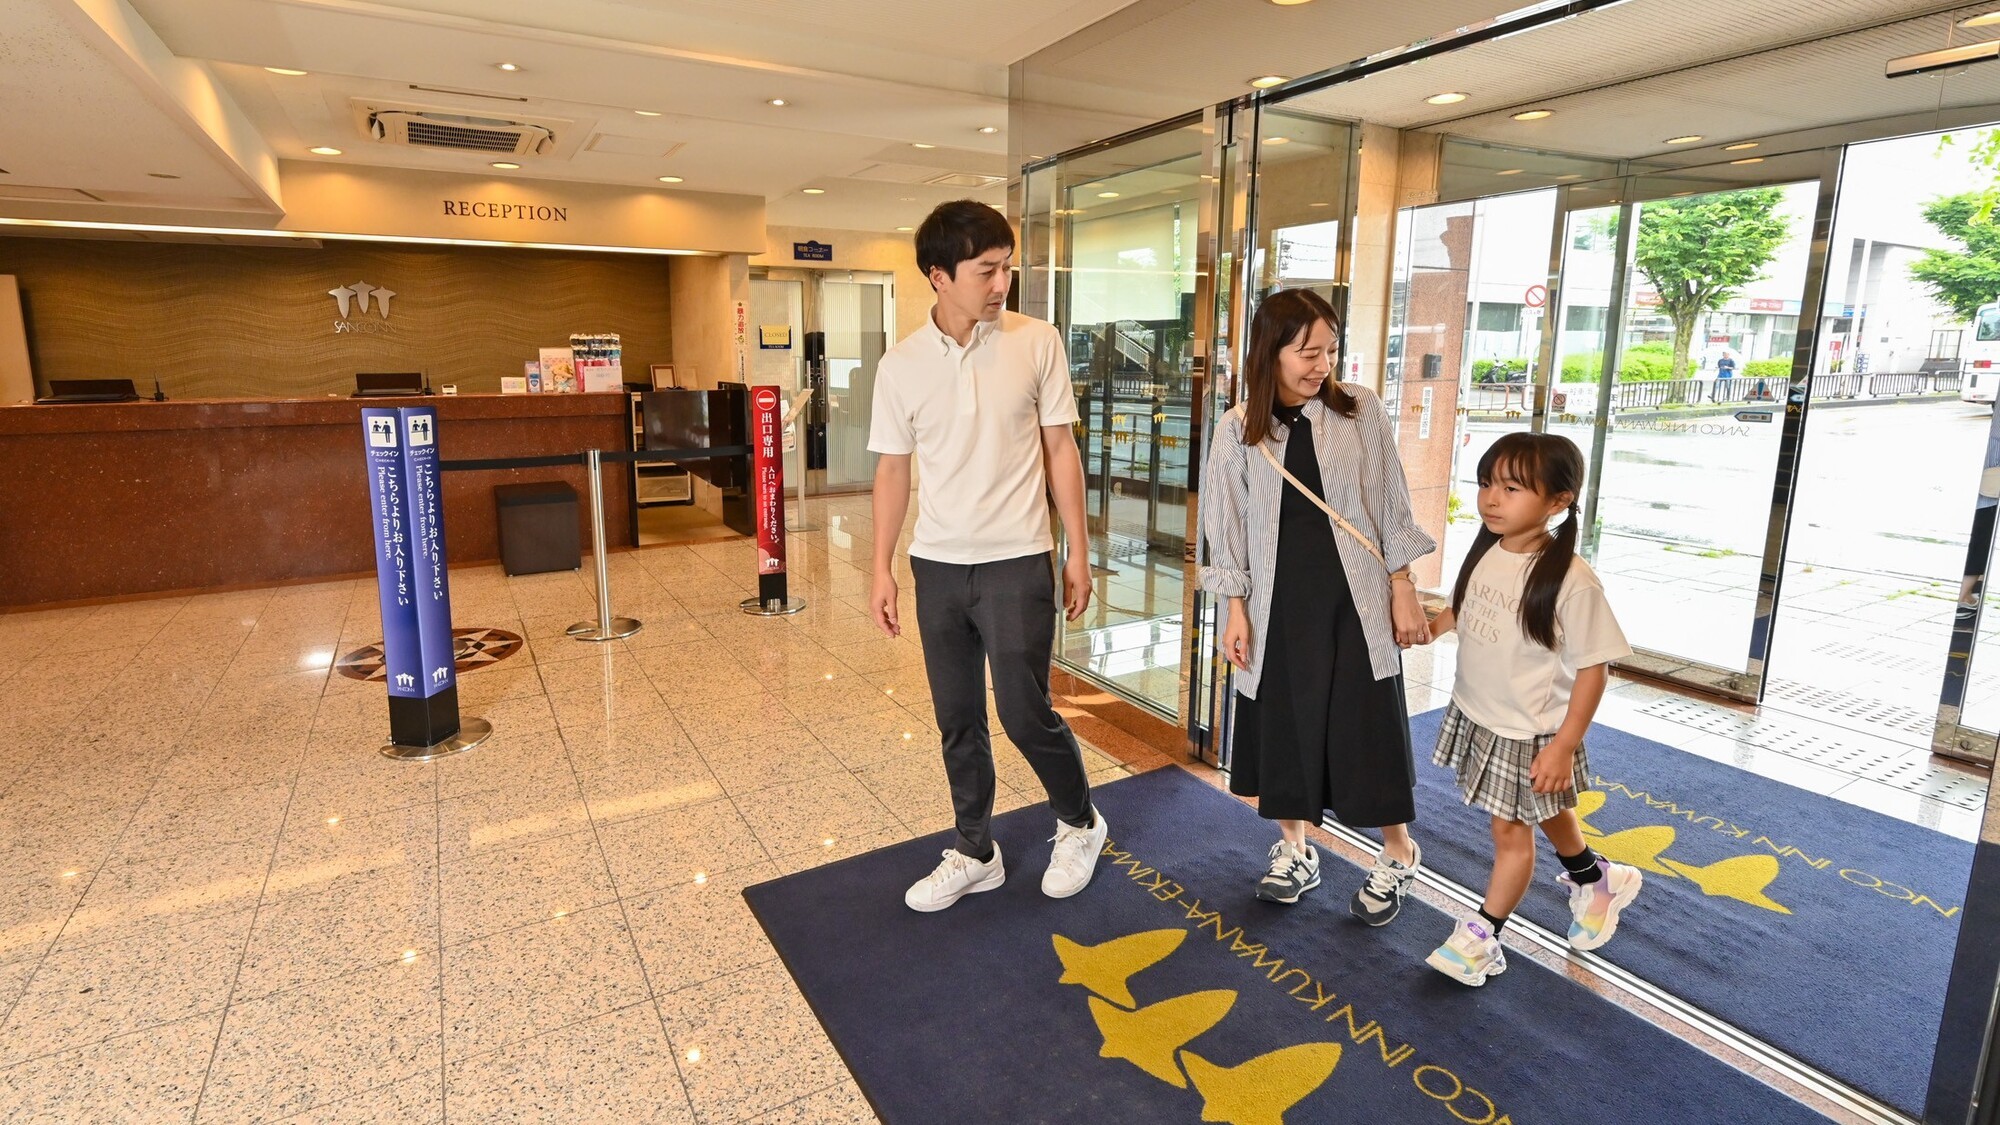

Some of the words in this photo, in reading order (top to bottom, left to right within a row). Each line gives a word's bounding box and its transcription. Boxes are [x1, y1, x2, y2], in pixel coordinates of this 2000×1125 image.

[443, 200, 567, 221] RECEPTION
[761, 412, 774, 458] 出口専用
[409, 447, 435, 456] チェックイン
[377, 466, 386, 492] Please
[415, 465, 423, 491] Please
[380, 494, 388, 516] enter
[382, 518, 391, 538] from
[387, 466, 409, 606] こちらよりお入り下さい
[419, 516, 427, 537] from
[424, 463, 443, 600] こちらよりお入り下さい
[384, 539, 392, 561] here.
[421, 537, 429, 559] here.
[1479, 603, 1499, 622] THE
[1752, 836, 1832, 870] INN
[1101, 838, 1337, 1011] KUWANA-EKIMA
[1326, 1003, 1416, 1068] INN
[1413, 1065, 1512, 1125] CO
